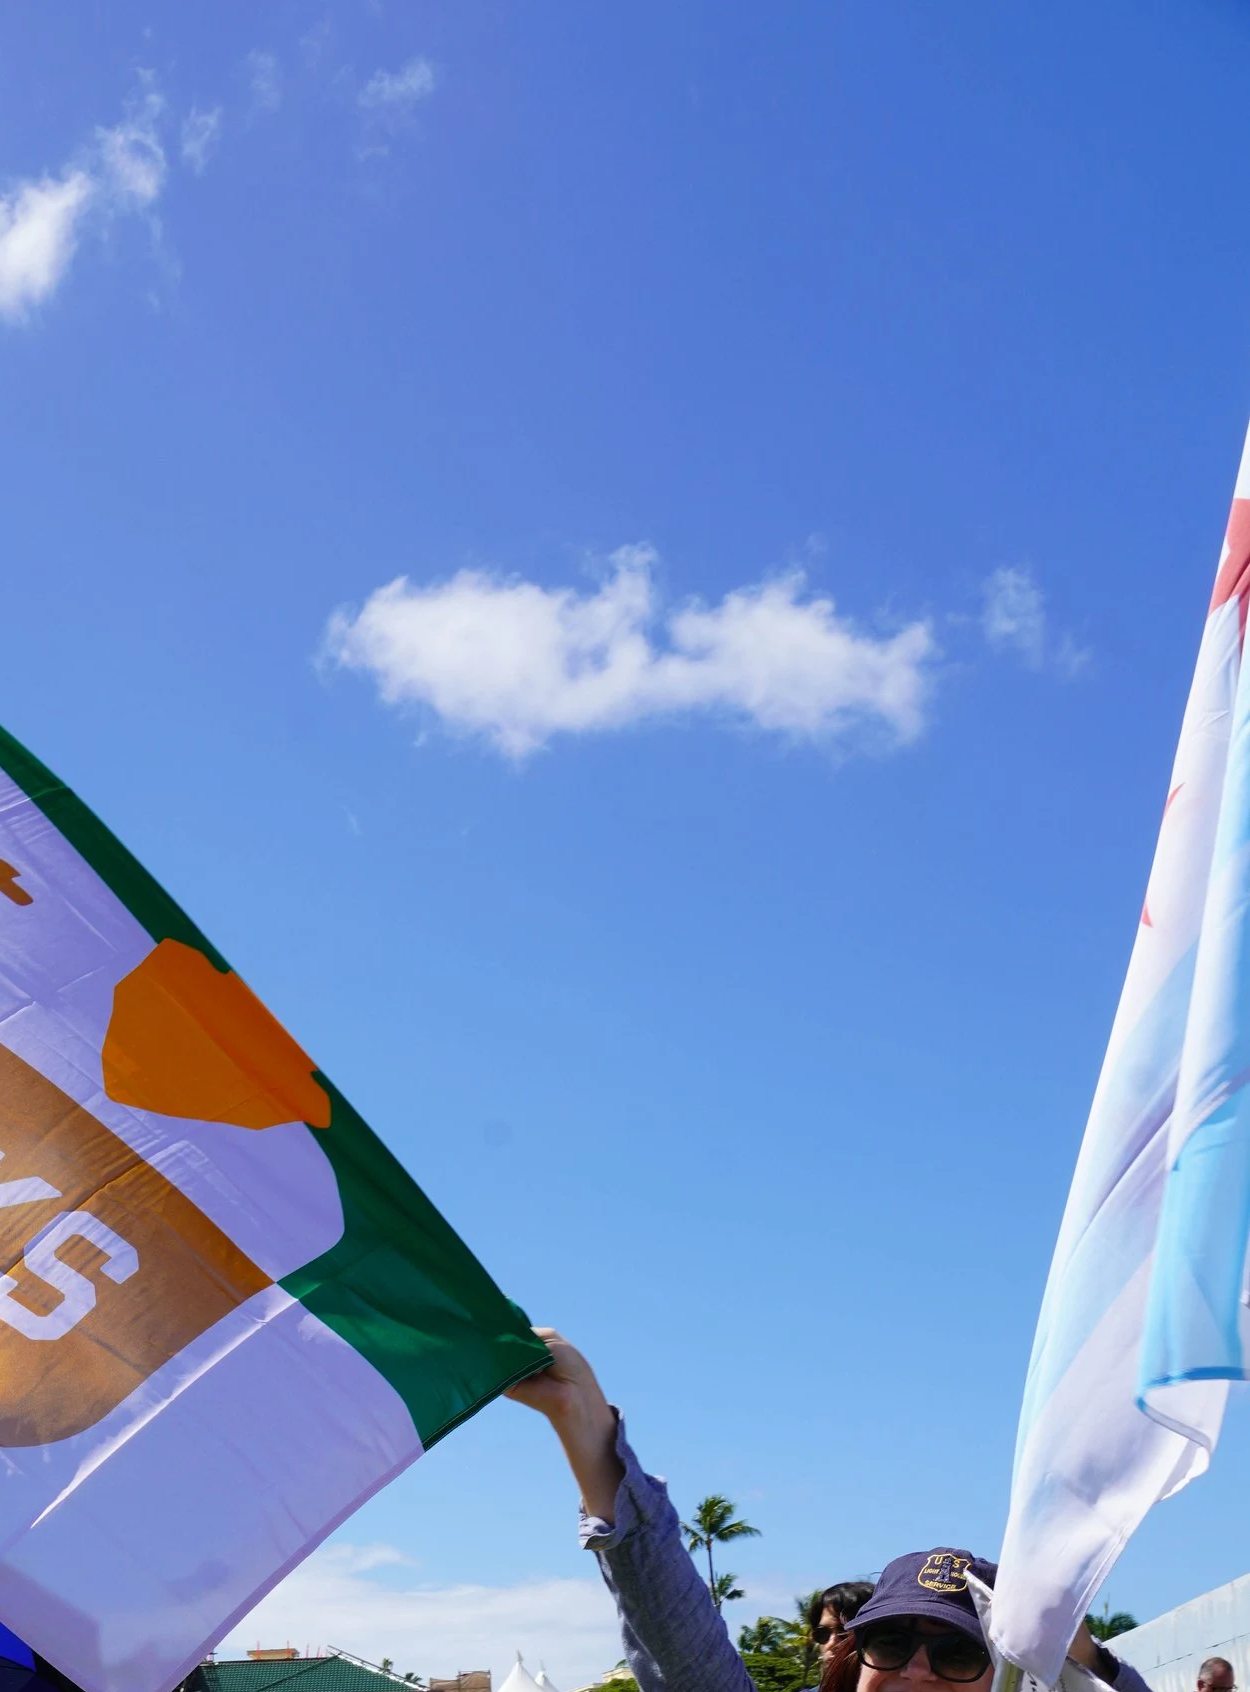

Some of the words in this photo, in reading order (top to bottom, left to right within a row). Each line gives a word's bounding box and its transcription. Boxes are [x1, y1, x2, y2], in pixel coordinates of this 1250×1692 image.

[934, 1556, 943, 1565] U
[953, 1560, 960, 1568] S
[924, 1579, 957, 1590] SERVICE
